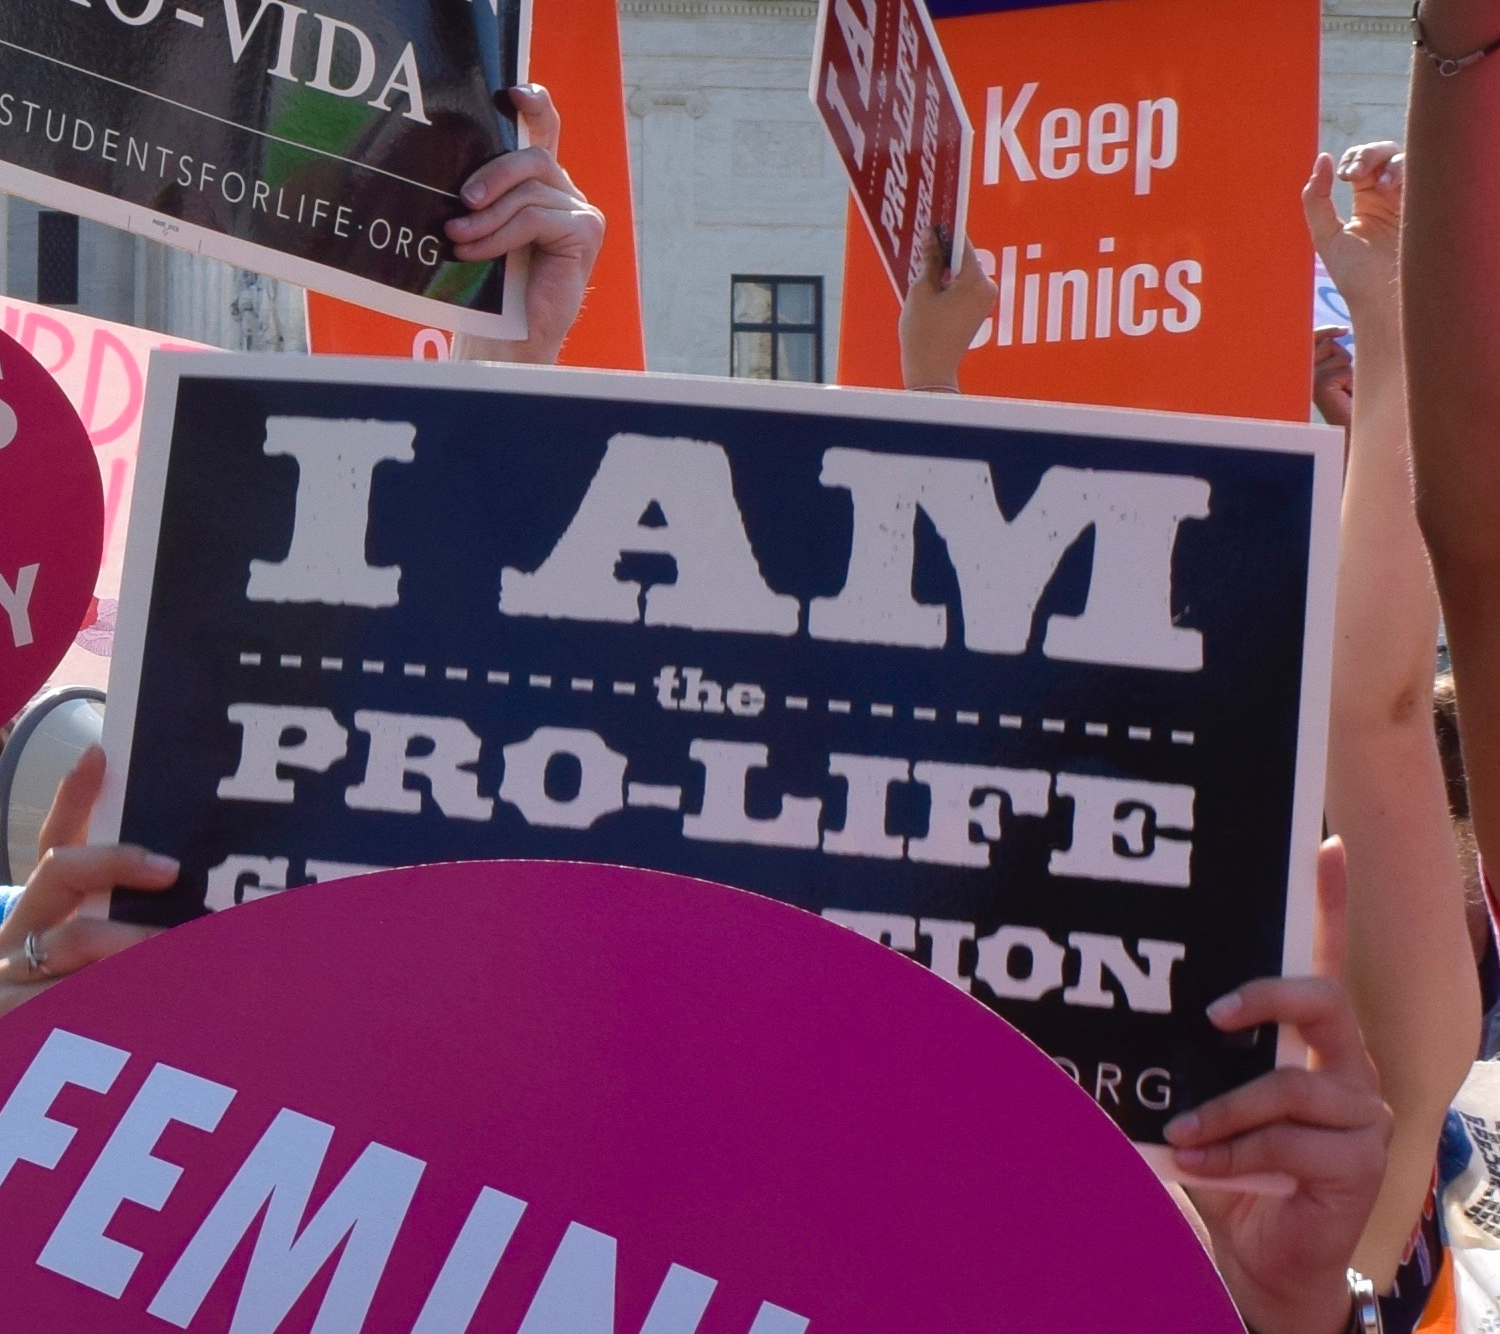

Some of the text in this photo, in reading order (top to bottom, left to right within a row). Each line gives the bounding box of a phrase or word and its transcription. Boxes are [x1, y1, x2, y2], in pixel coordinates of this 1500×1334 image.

[982, 81, 1180, 196] Keep
[244, 414, 1211, 671] I AM
[653, 666, 766, 716] the
[217, 702, 1195, 889] PRO-LIFE
